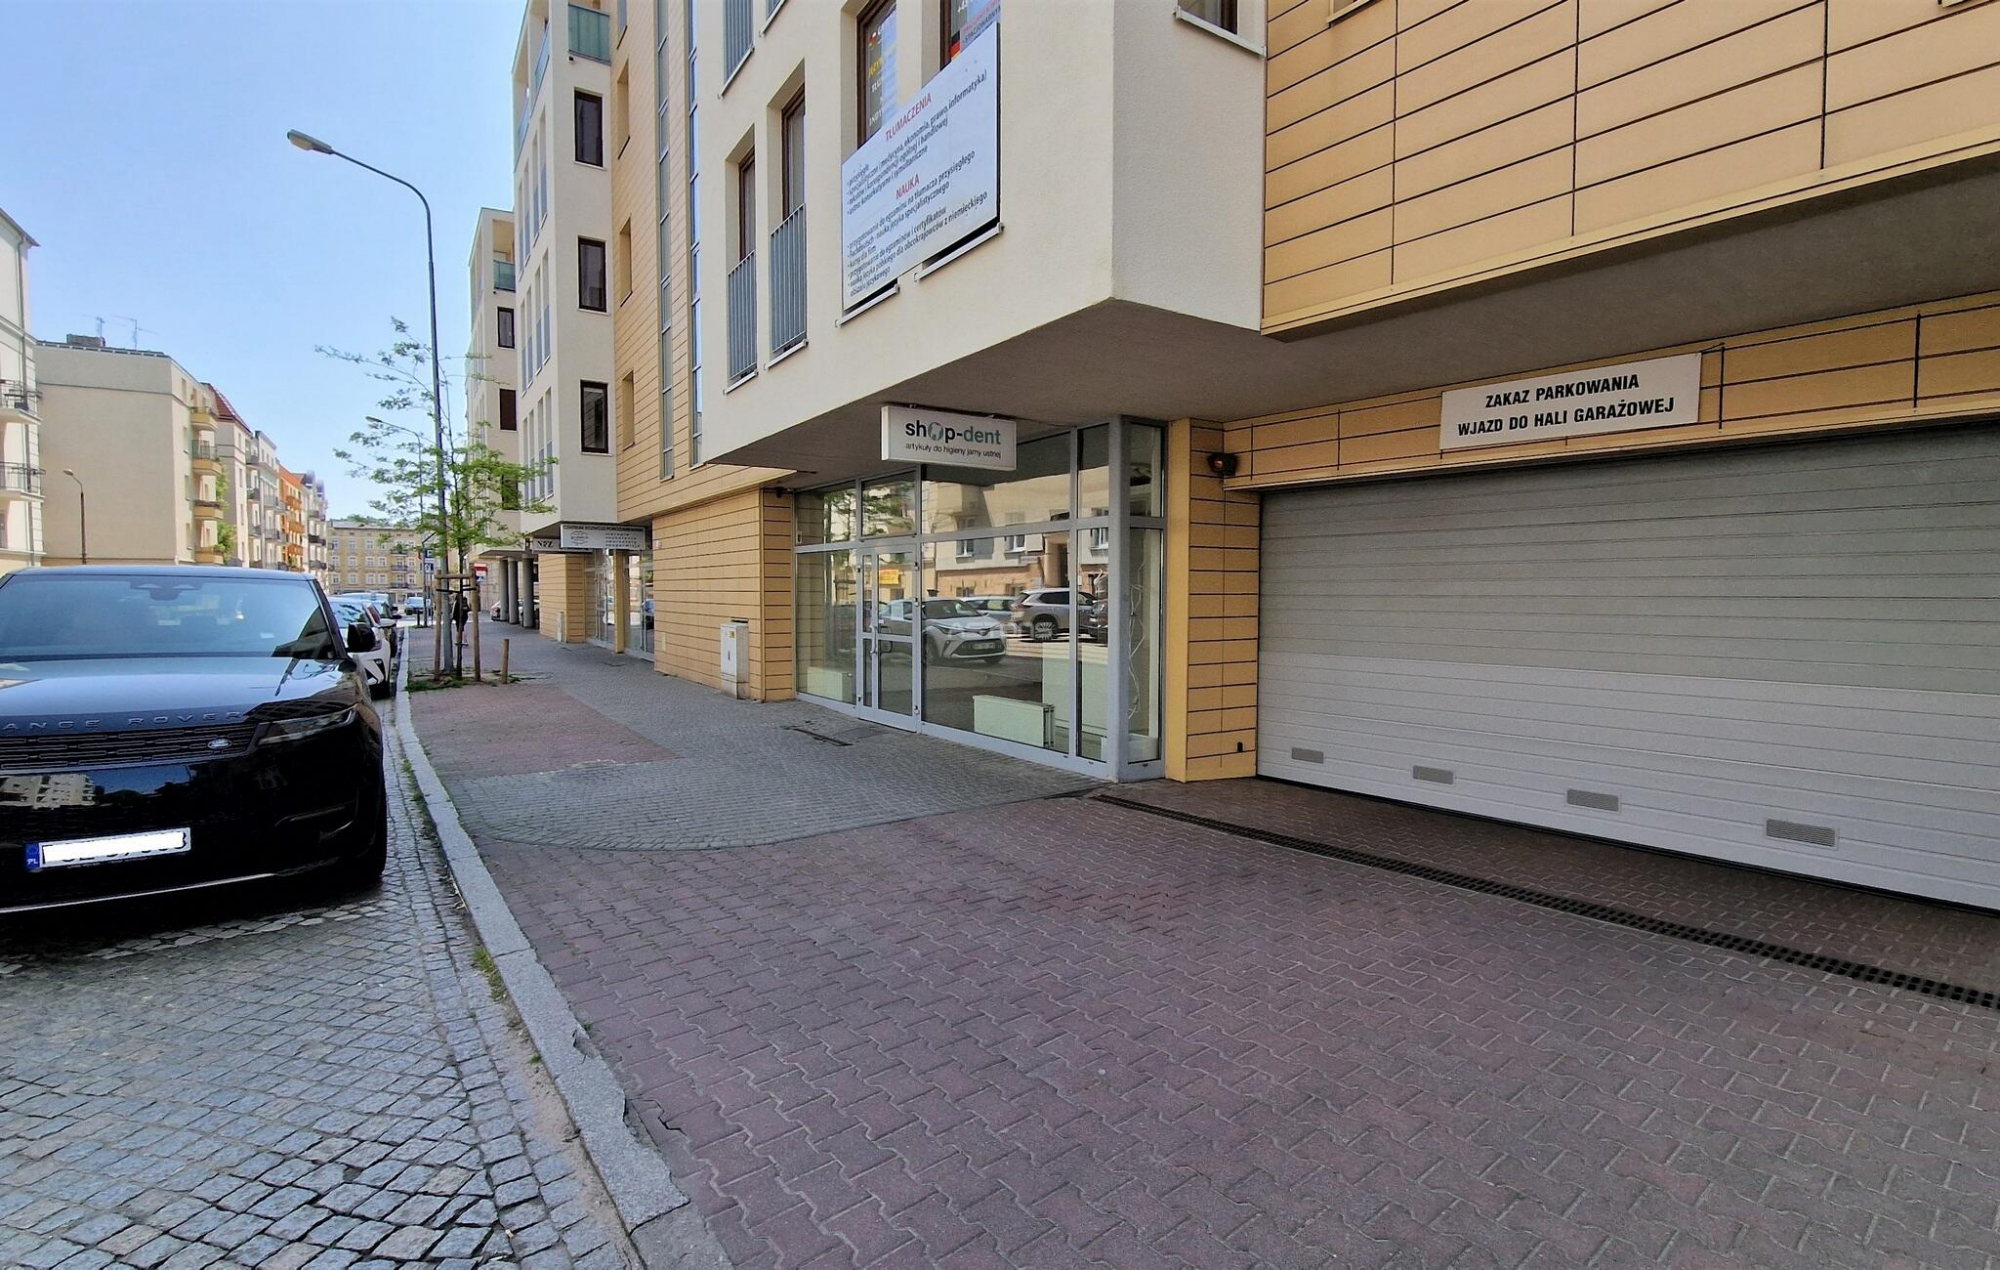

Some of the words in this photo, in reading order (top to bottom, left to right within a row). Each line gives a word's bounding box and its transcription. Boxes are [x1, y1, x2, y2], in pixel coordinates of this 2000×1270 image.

[885, 93, 931, 140] TŁUMACZENIA
[920, 117, 947, 144] handlowej
[896, 173, 919, 198] NAUKA
[914, 178, 937, 199] tłumacza
[938, 151, 974, 183] przysięgłego
[904, 181, 949, 217] specjalistycznego
[948, 191, 987, 221] niemieckiego
[913, 207, 946, 233] certyfikatów
[1485, 390, 1530, 408] ZAKAZ
[1535, 374, 1639, 401] PARKOWANIA
[1458, 418, 1503, 436] WJAZD
[1509, 415, 1528, 431] DO
[1534, 410, 1567, 427] HALI
[1574, 397, 1675, 423] GARAŻOWEJ
[905, 443, 932, 453] artykuły
[933, 445, 942, 453] do
[943, 445, 965, 456] higieny
[966, 447, 981, 457] jamy
[983, 450, 1001, 459] ustnej
[3, 720, 100, 731] ANGE
[128, 711, 243, 725] ROVER
